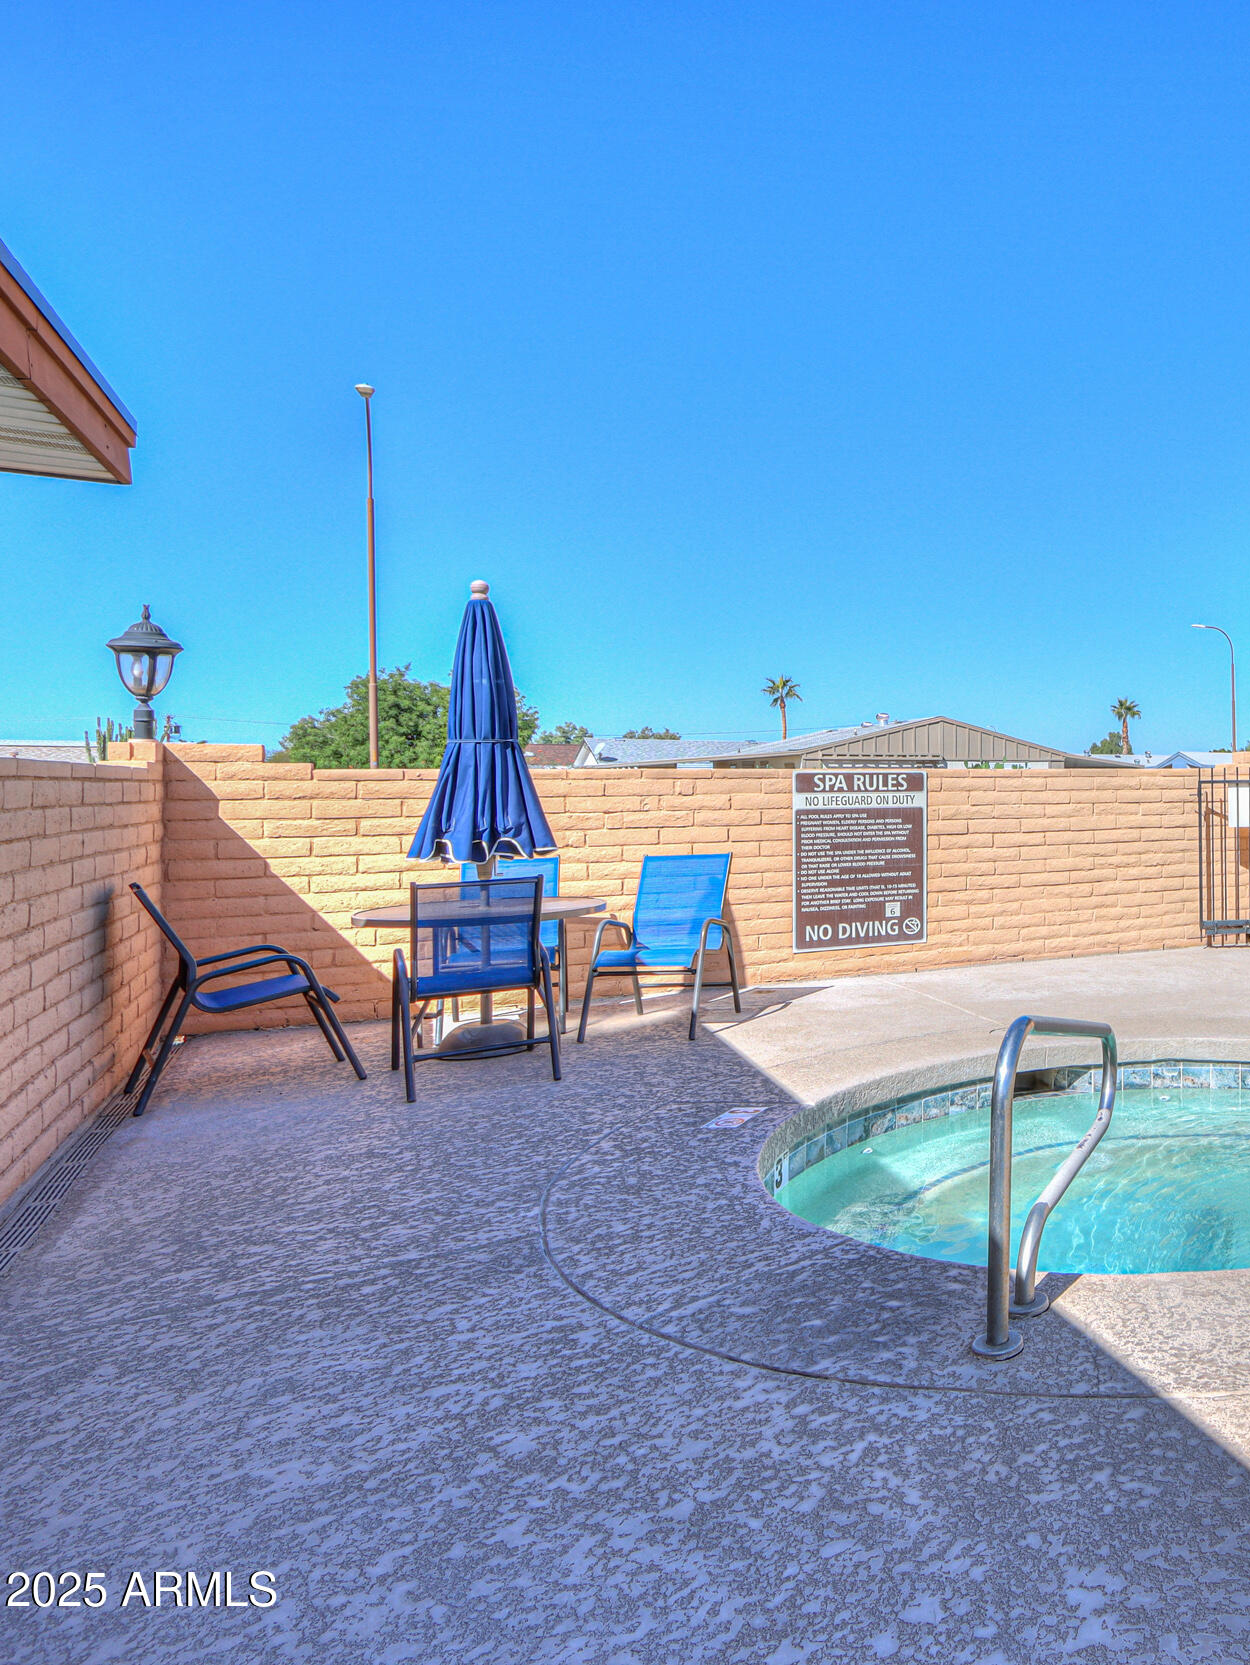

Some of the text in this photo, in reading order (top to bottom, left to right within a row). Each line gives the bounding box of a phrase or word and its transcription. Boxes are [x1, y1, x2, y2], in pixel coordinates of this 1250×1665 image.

[814, 774, 908, 791] SPA RULES
[805, 794, 915, 806] NO LIFEGUARD ON DUTY
[805, 920, 898, 941] NO DIVING
[775, 1158, 783, 1188] 3
